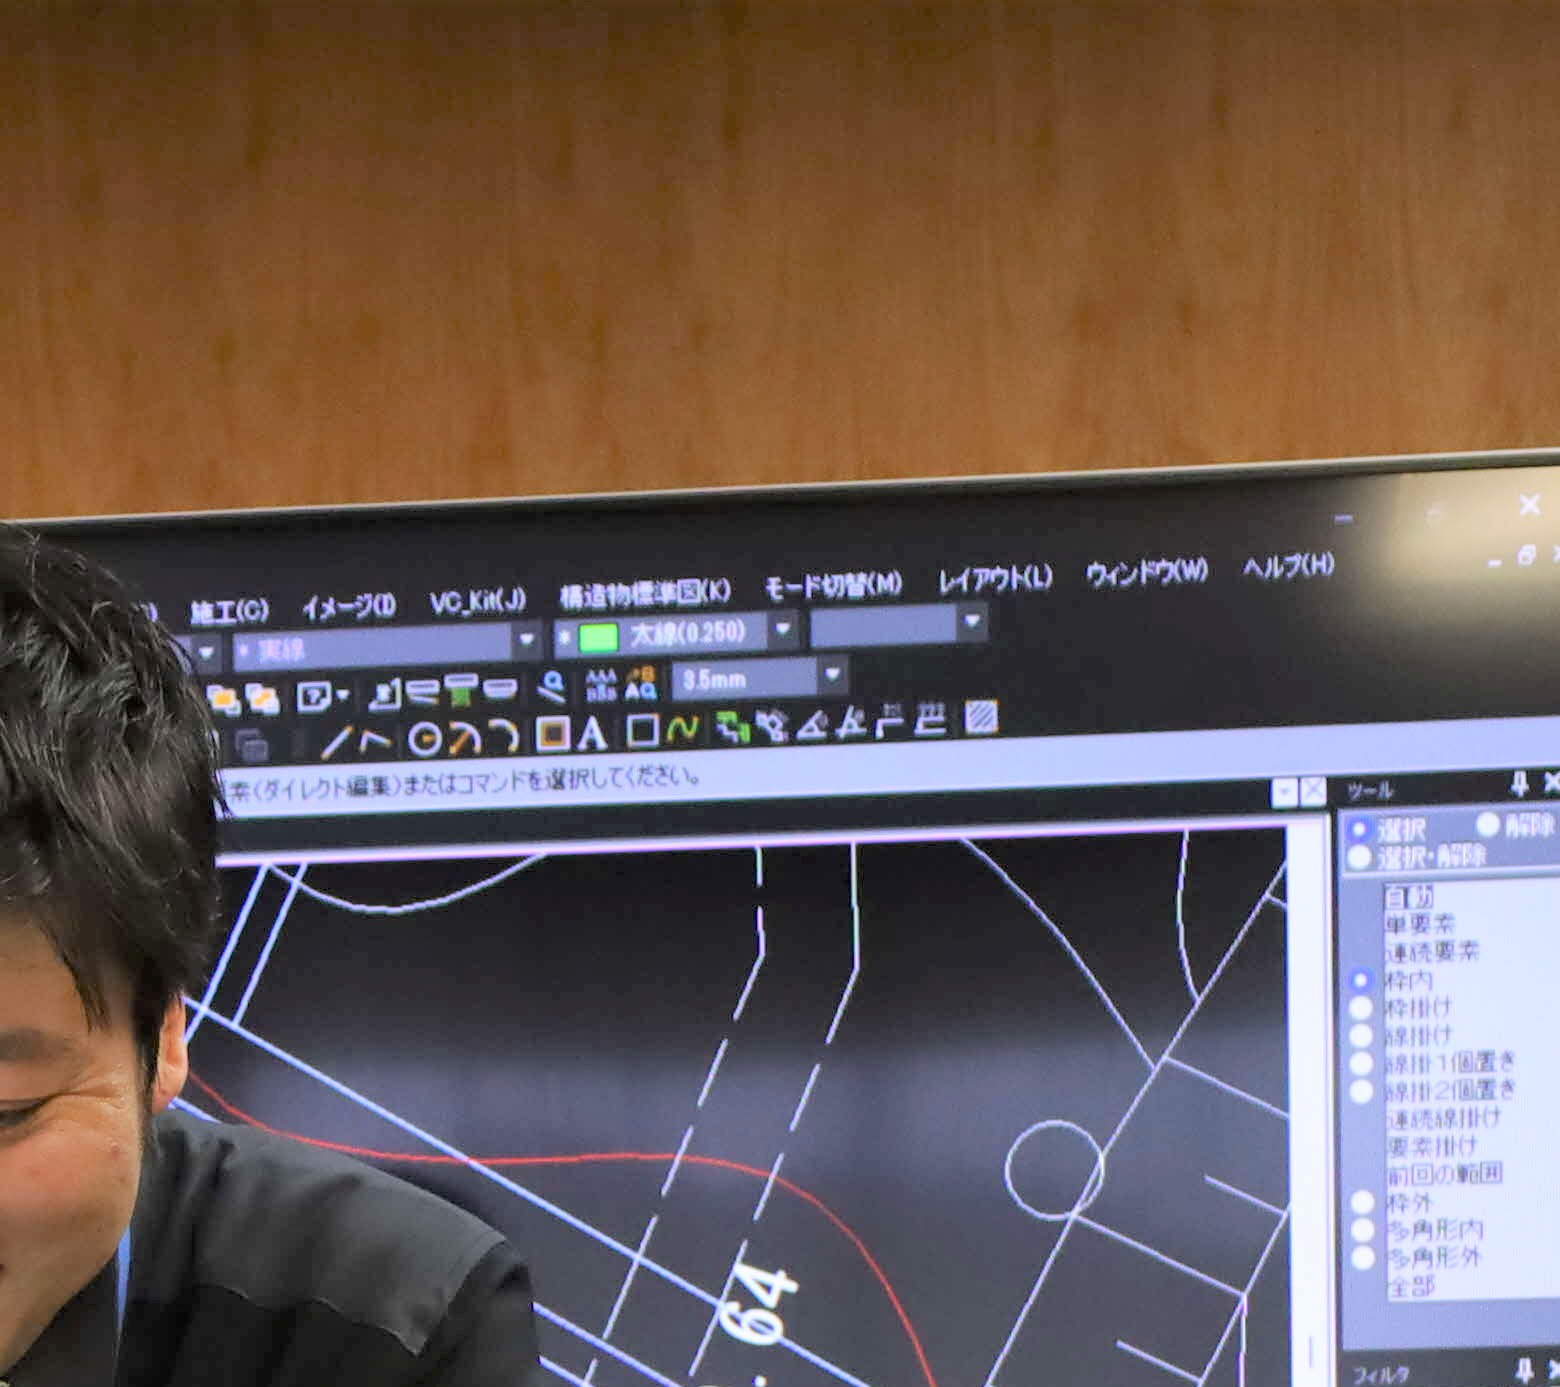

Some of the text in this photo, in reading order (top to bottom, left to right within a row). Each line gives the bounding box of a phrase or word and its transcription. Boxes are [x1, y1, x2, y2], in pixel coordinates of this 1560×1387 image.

[940, 563, 1054, 594] レイアウト(L)
[1086, 556, 1208, 587] ウィンドウ(W)
[1243, 551, 1335, 579] ヘルプ(H)
[766, 570, 903, 600] モード切替(M)
[190, 597, 269, 626] 施工(C)
[683, 668, 747, 691] 3.5mm
[1348, 780, 1394, 800] ツール
[1378, 817, 1426, 842] 選択
[1353, 1365, 1410, 1385] フィルタ
